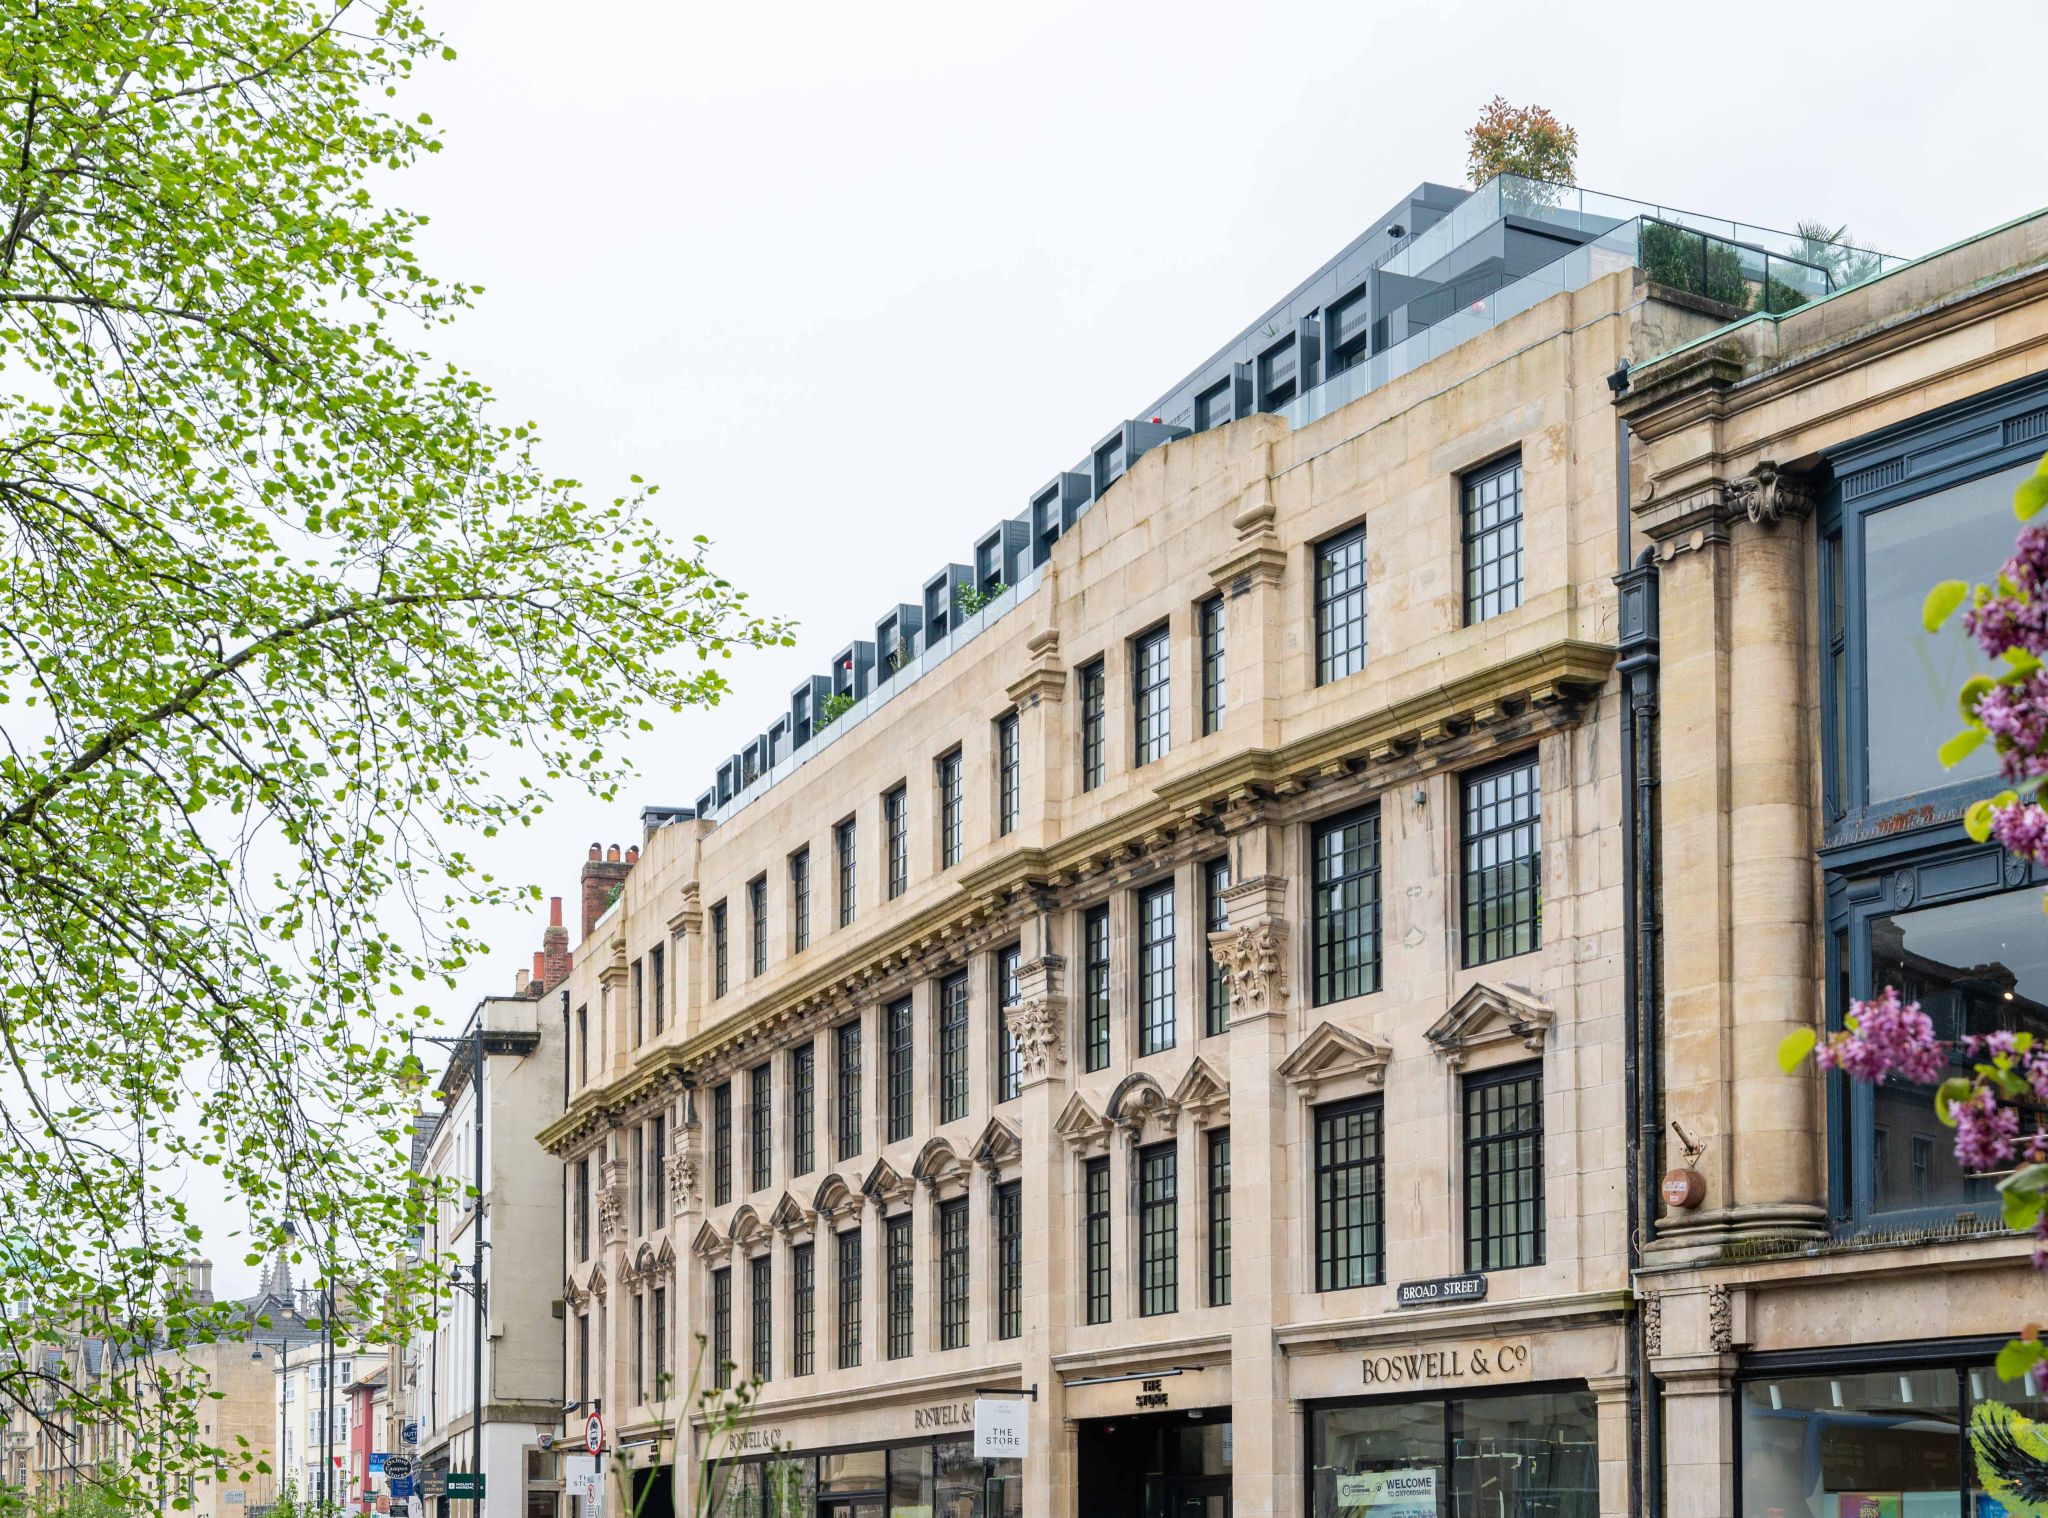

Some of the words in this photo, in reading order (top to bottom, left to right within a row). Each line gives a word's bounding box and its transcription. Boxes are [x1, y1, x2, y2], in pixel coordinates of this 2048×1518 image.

[1403, 1284, 1438, 1300] BROAD
[1444, 1279, 1480, 1296] STREET
[1361, 1350, 1465, 1385] BOSWELL
[1471, 1348, 1491, 1375] &
[1141, 1379, 1162, 1392] THE
[1136, 1393, 1169, 1408] STORE
[914, 1404, 960, 1429] BOSWELL
[961, 1402, 971, 1424] &
[993, 1428, 1013, 1437] THE
[729, 1430, 762, 1450] BOSWELL
[985, 1436, 1020, 1446] STORE
[386, 1458, 409, 1466] Oxford
[1386, 1477, 1432, 1490] WELCOME
[1395, 1489, 1432, 1498] OXFORDSHIRE
